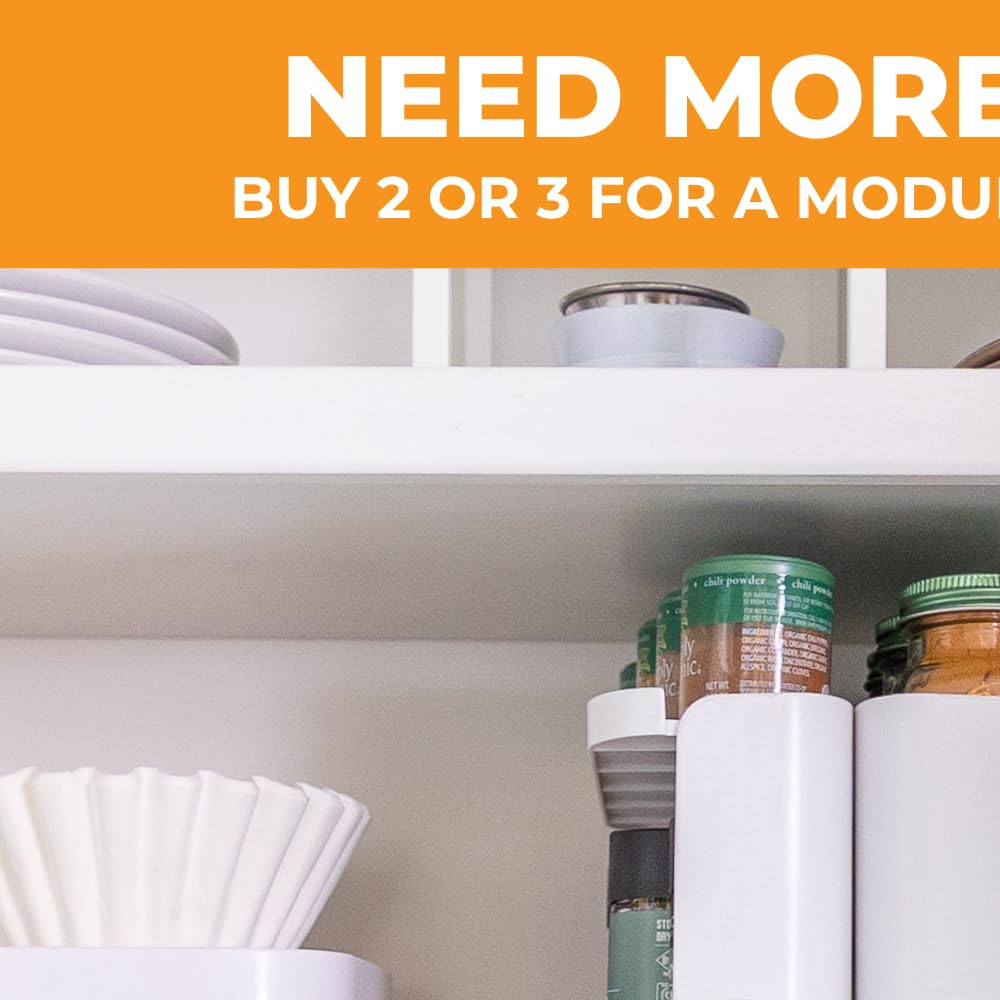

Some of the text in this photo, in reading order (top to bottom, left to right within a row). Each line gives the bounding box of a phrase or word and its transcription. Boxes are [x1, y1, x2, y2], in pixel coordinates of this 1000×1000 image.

[703, 574, 766, 589] chili powder
[791, 579, 812, 591] chili
